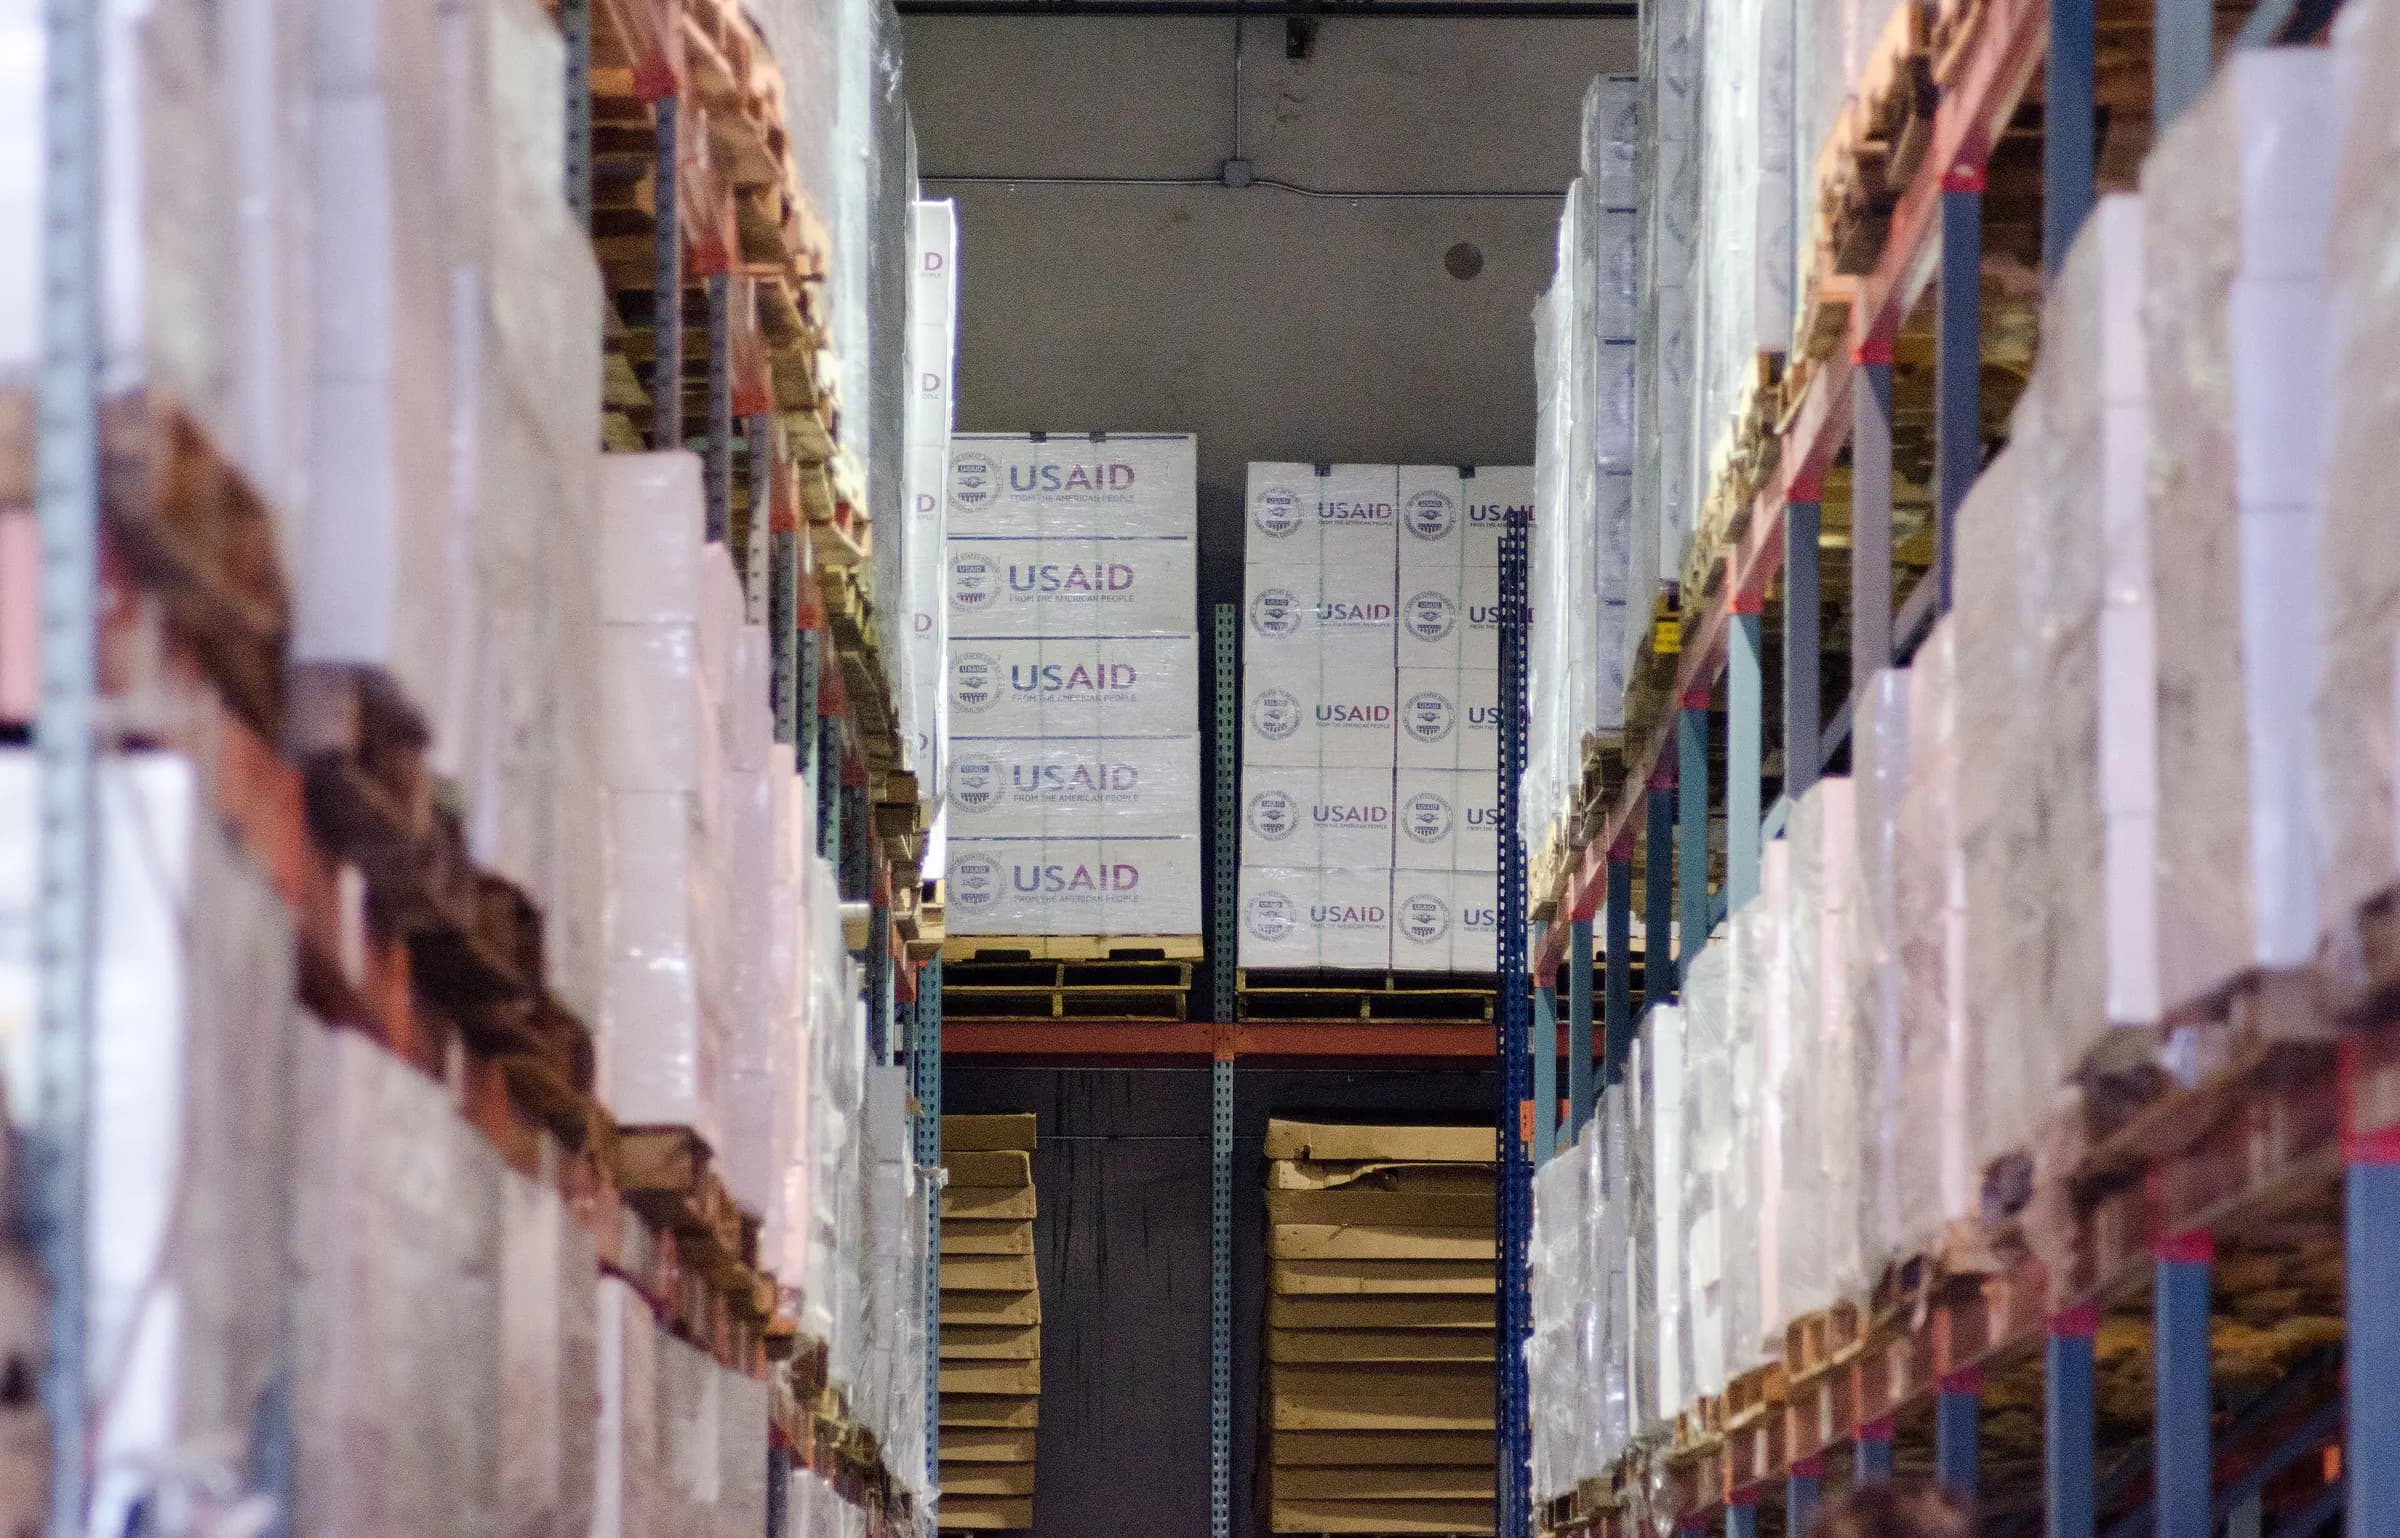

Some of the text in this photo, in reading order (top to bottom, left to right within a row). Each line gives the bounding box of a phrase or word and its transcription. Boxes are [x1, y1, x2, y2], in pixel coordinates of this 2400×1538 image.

[1010, 464, 1135, 491] USAID
[1318, 502, 1392, 519] USAID
[1009, 564, 1134, 592] USAID
[1316, 603, 1390, 620] USAID
[1012, 664, 1137, 691] USAID
[1315, 704, 1390, 721] USAID
[1013, 763, 1138, 791] USAID
[1313, 805, 1387, 822] USAID
[1014, 864, 1139, 892] USAID
[1310, 905, 1384, 922] USAID
